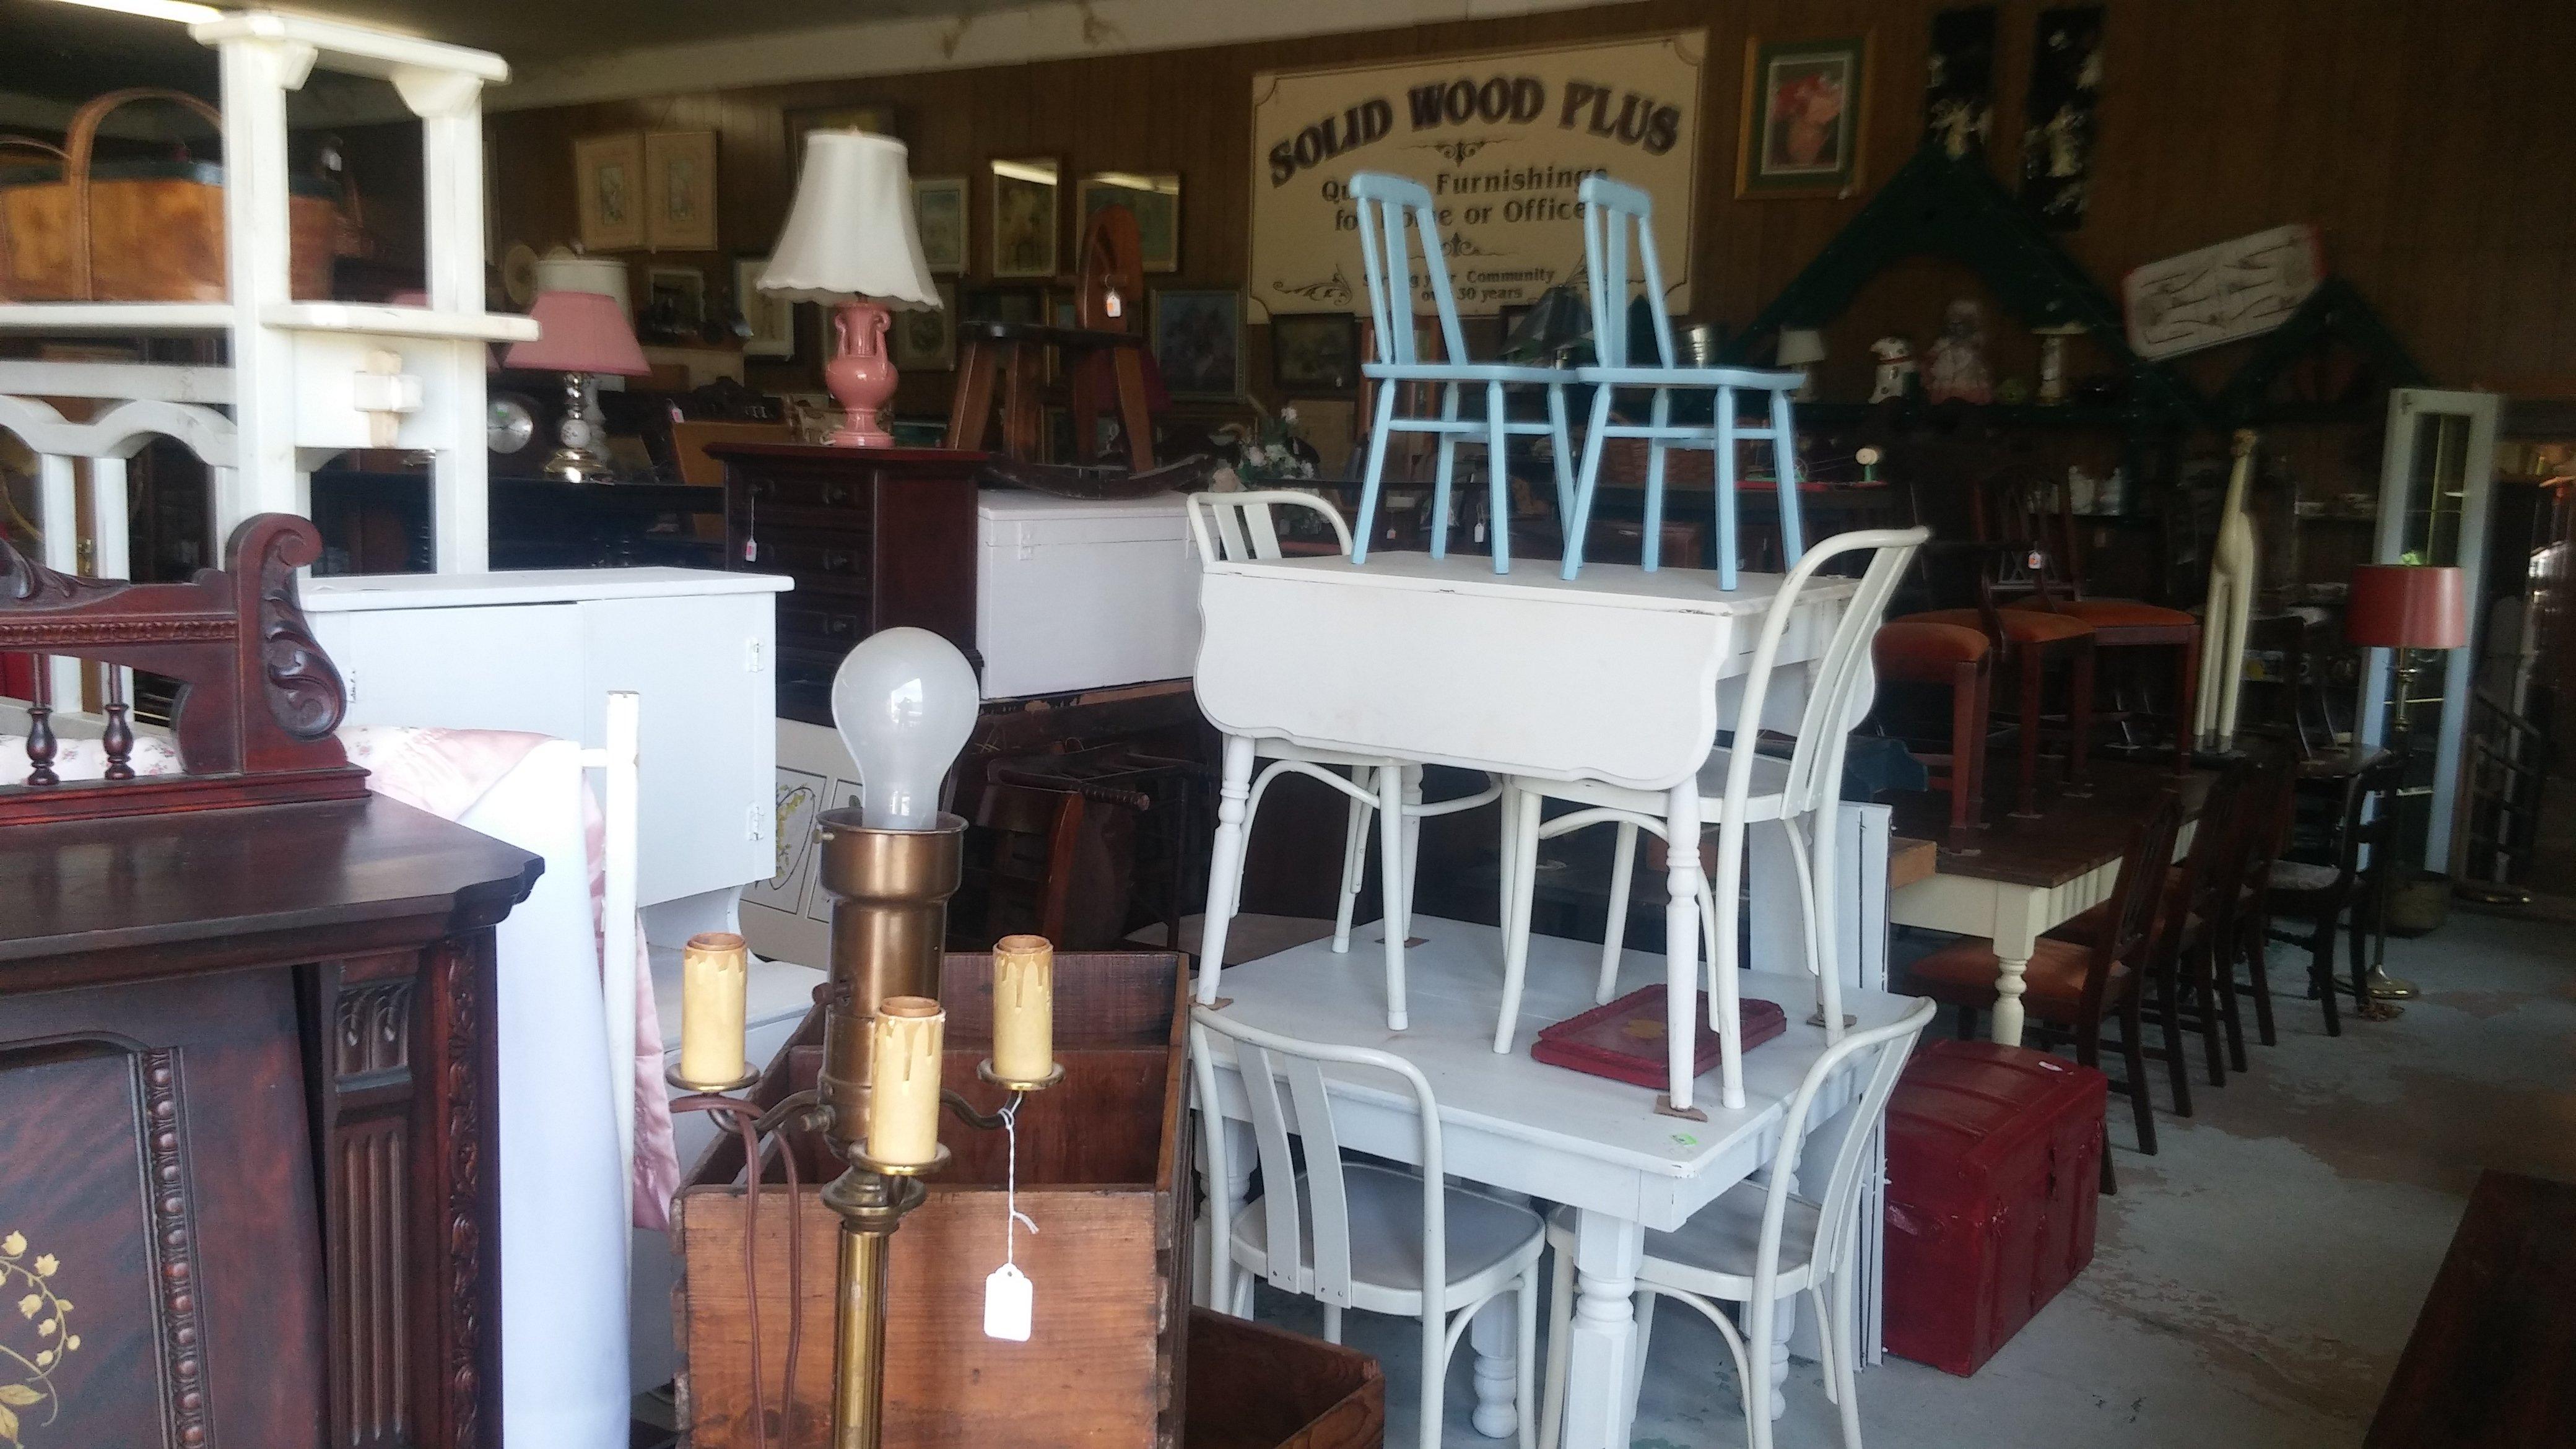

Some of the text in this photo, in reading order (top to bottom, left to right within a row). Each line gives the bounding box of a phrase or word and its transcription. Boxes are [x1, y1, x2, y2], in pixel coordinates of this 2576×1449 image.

[1269, 76, 1681, 188] SOLID WOOD PLUS
[1335, 209, 1360, 231] fo
[1464, 206, 1493, 224] or
[1503, 197, 1585, 223] Office
[1466, 268, 1555, 283] Community
[1457, 287, 1523, 303] 30 years
